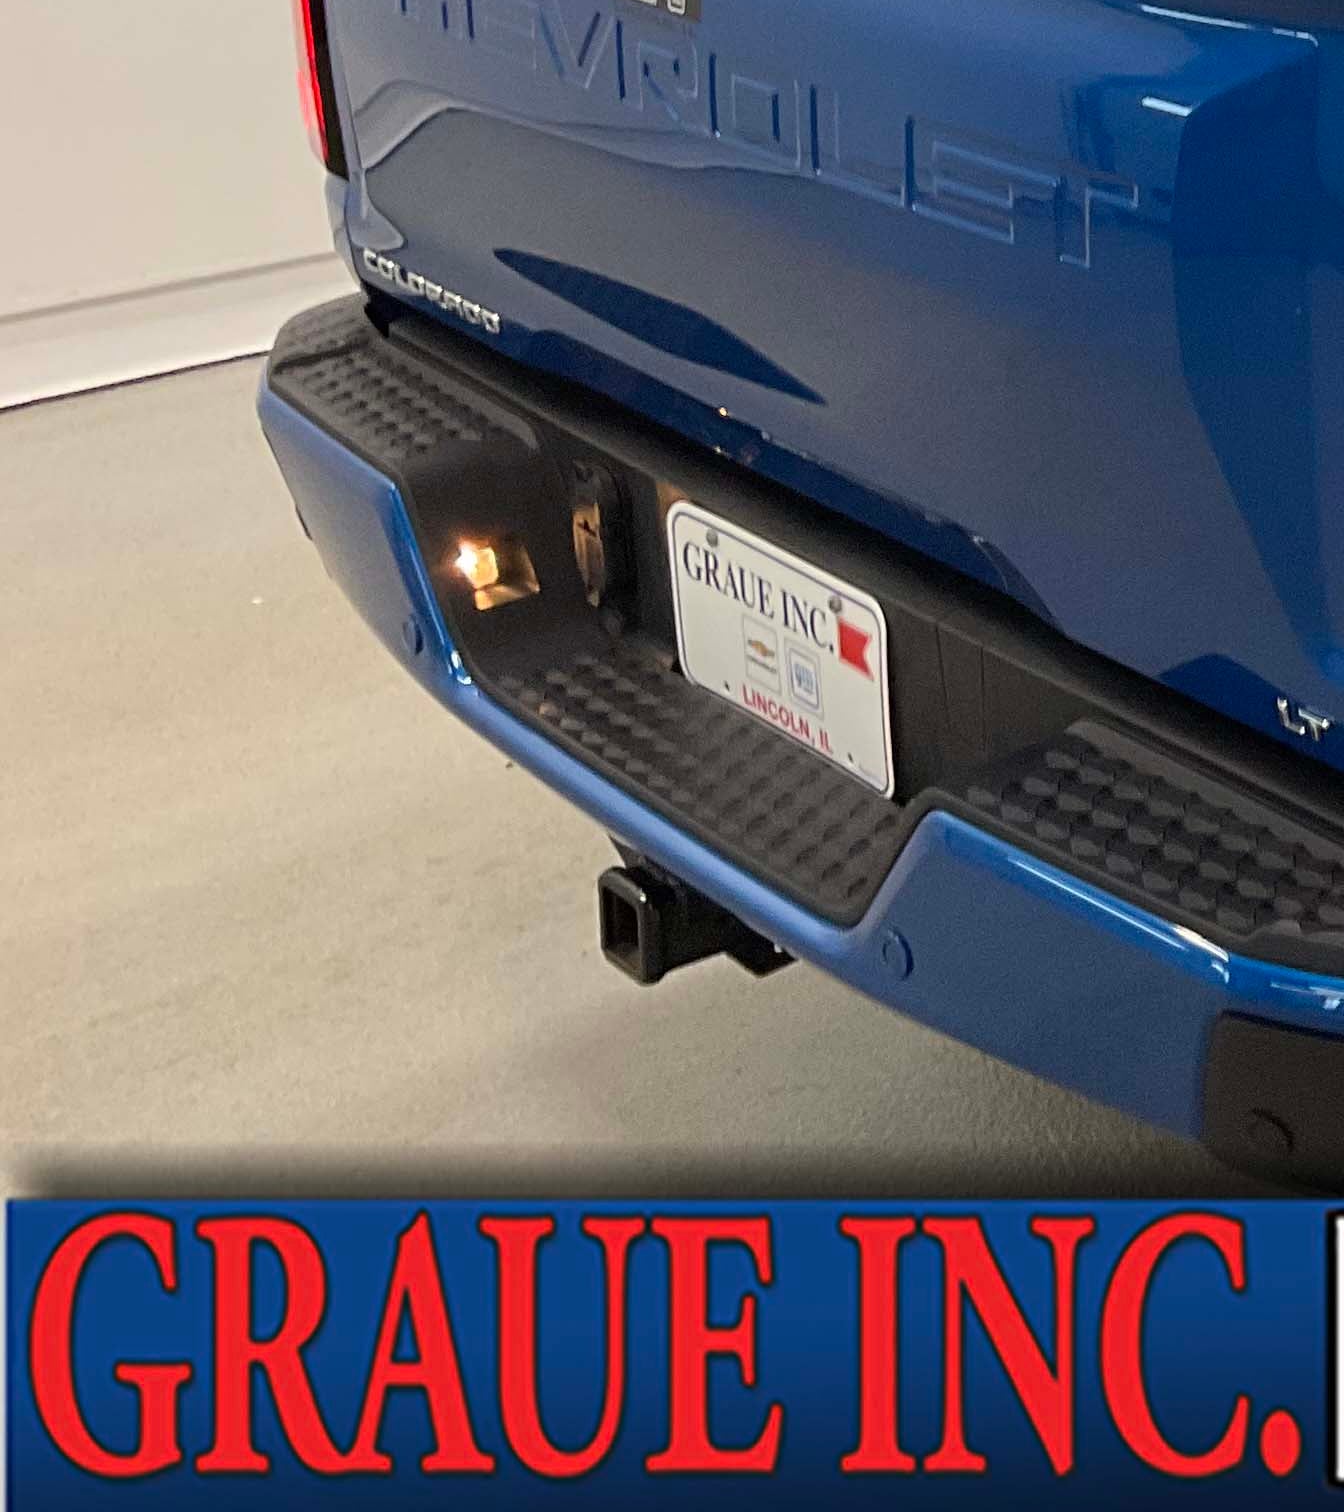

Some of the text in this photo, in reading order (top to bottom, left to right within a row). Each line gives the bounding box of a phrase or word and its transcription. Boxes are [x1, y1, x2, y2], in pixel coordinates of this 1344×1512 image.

[363, 247, 500, 334] COLORADO
[682, 541, 834, 654] GRAUE INC.
[818, 728, 834, 755] IL
[1276, 696, 1330, 742] LT
